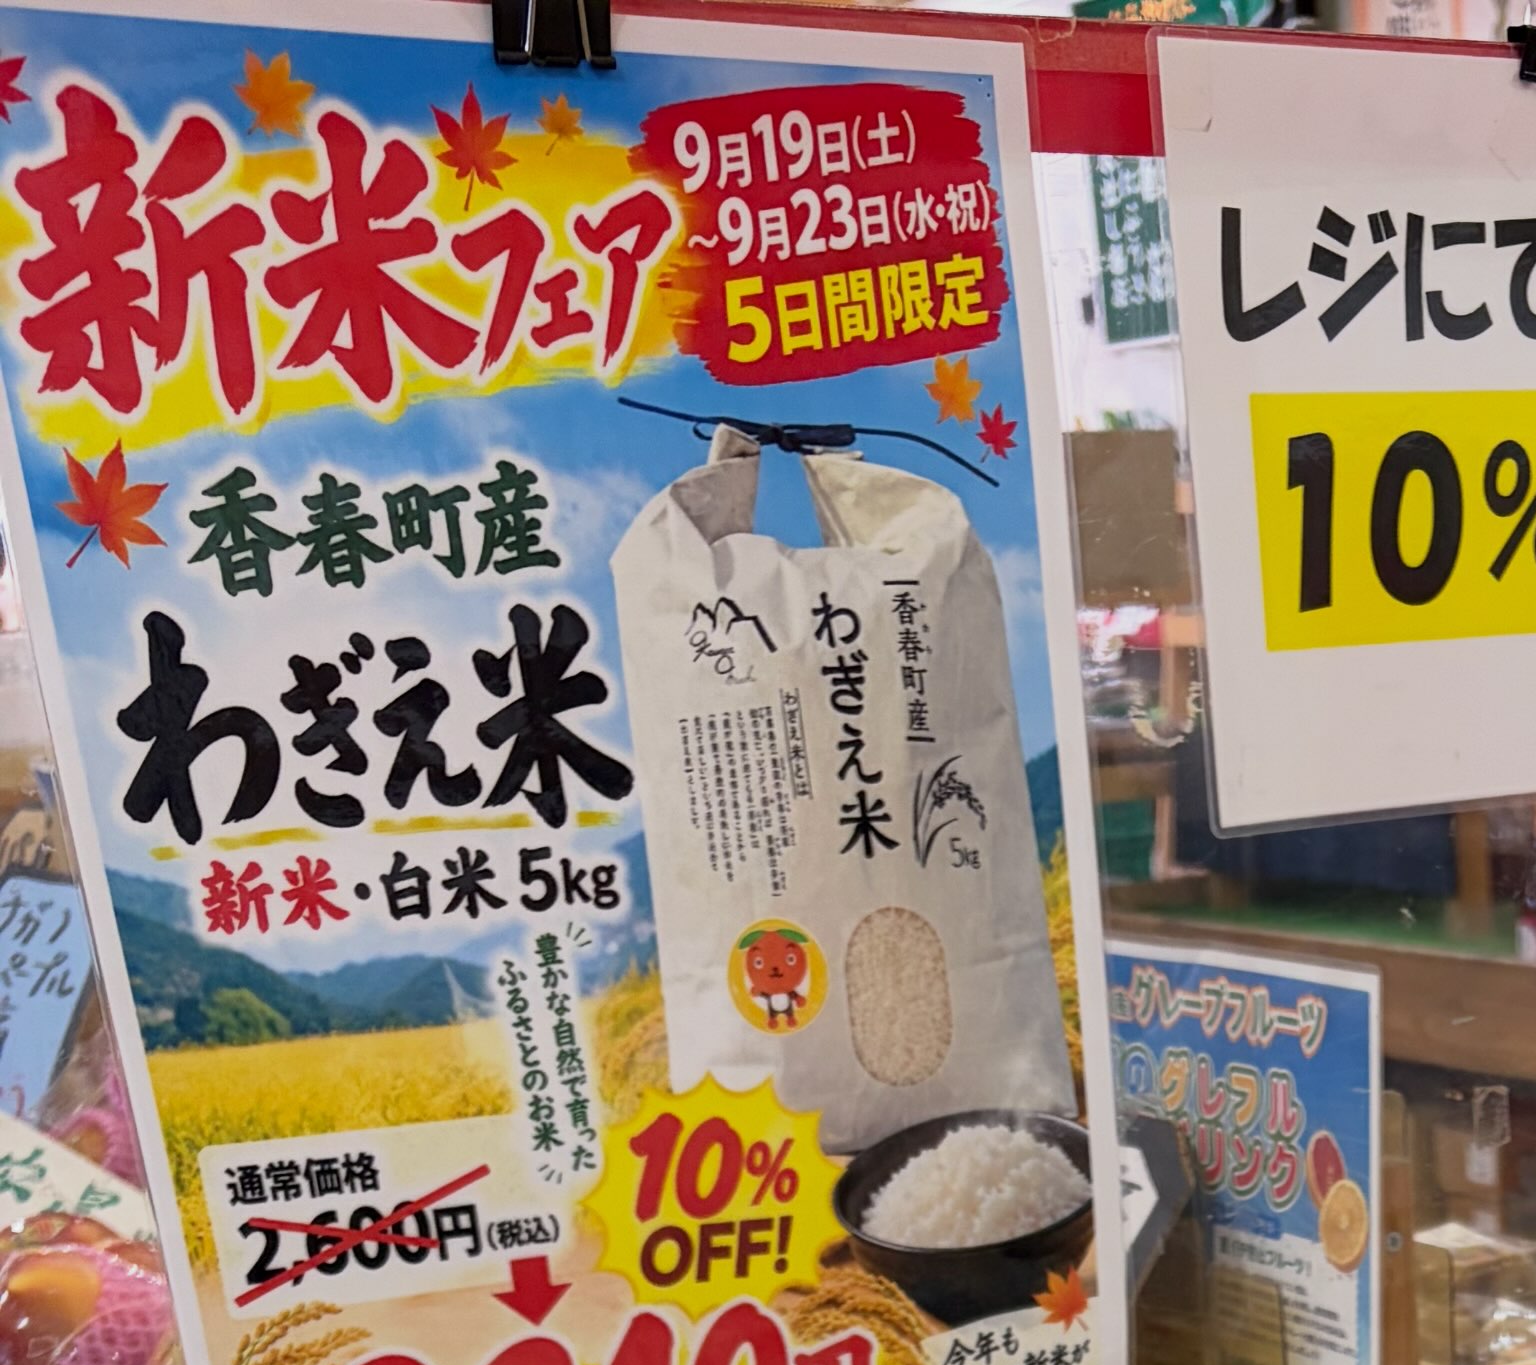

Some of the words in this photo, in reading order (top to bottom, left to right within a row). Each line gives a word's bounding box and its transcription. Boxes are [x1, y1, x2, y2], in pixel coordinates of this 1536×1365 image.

[672, 107, 917, 196] 9月19日(土)
[15, 82, 676, 417] 新米フェア
[724, 251, 991, 365] 5日間限定
[190, 460, 562, 598] 香春町産
[115, 602, 635, 847] わぎえ米
[811, 592, 900, 859] わぎえ米
[498, 960, 563, 1152] ふるさとのお米
[534, 932, 597, 1171] 豊かな自然で育った
[225, 1152, 382, 1206] 通常価格
[628, 1110, 798, 1225] 10%
[640, 1218, 791, 1290] OFF!
